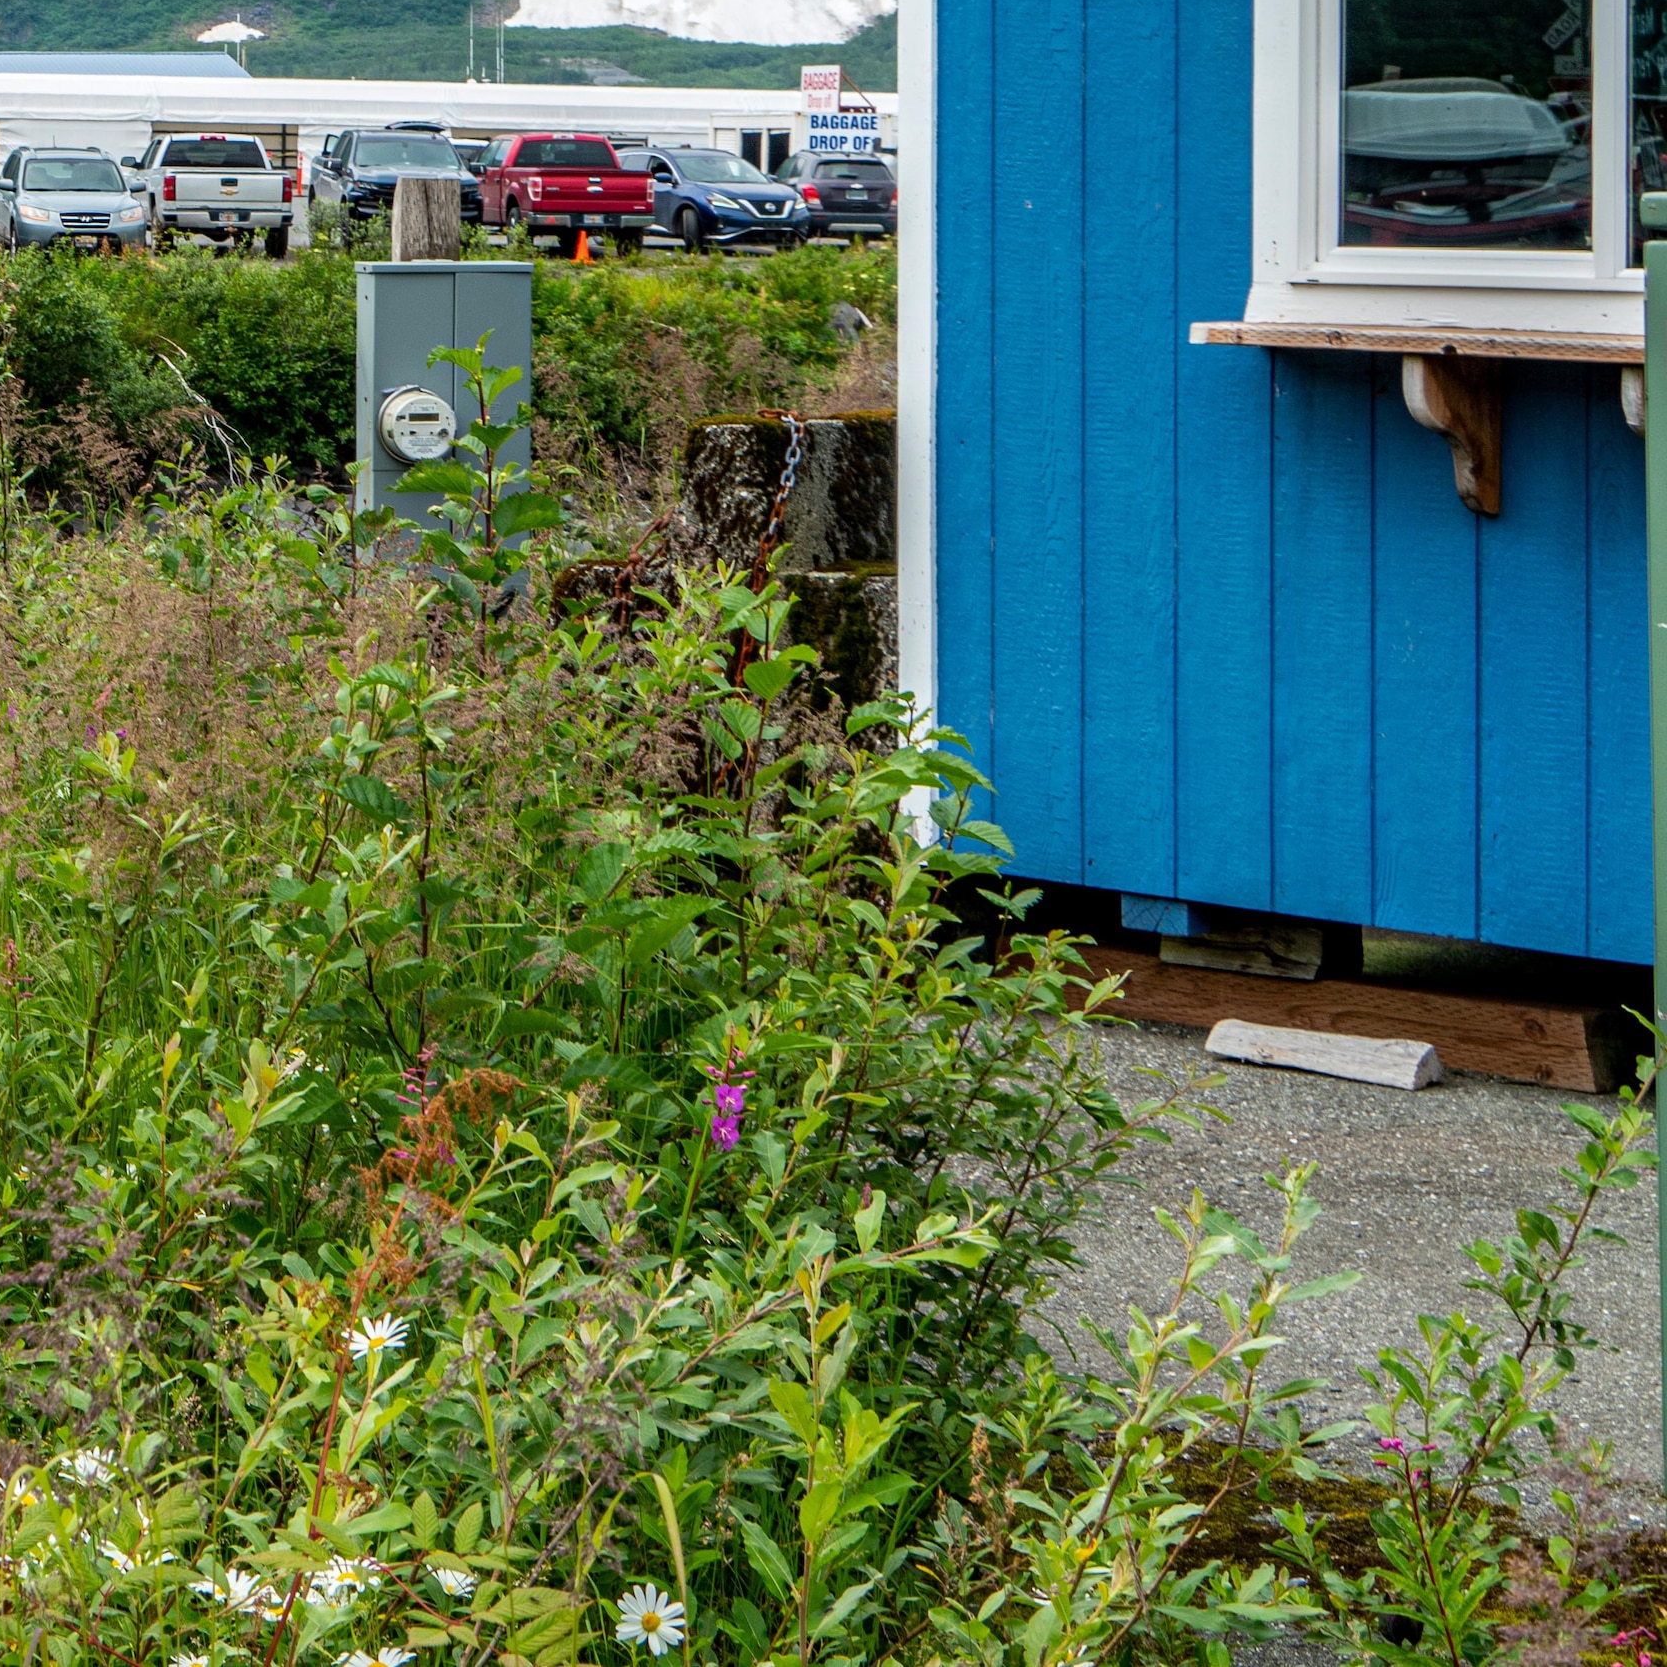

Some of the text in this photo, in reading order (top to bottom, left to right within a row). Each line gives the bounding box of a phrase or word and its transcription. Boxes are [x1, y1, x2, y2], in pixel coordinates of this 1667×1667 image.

[803, 72, 838, 90] BAGGAGE
[810, 115, 878, 130] BAGGAGE
[809, 135, 873, 151] DROP OF
